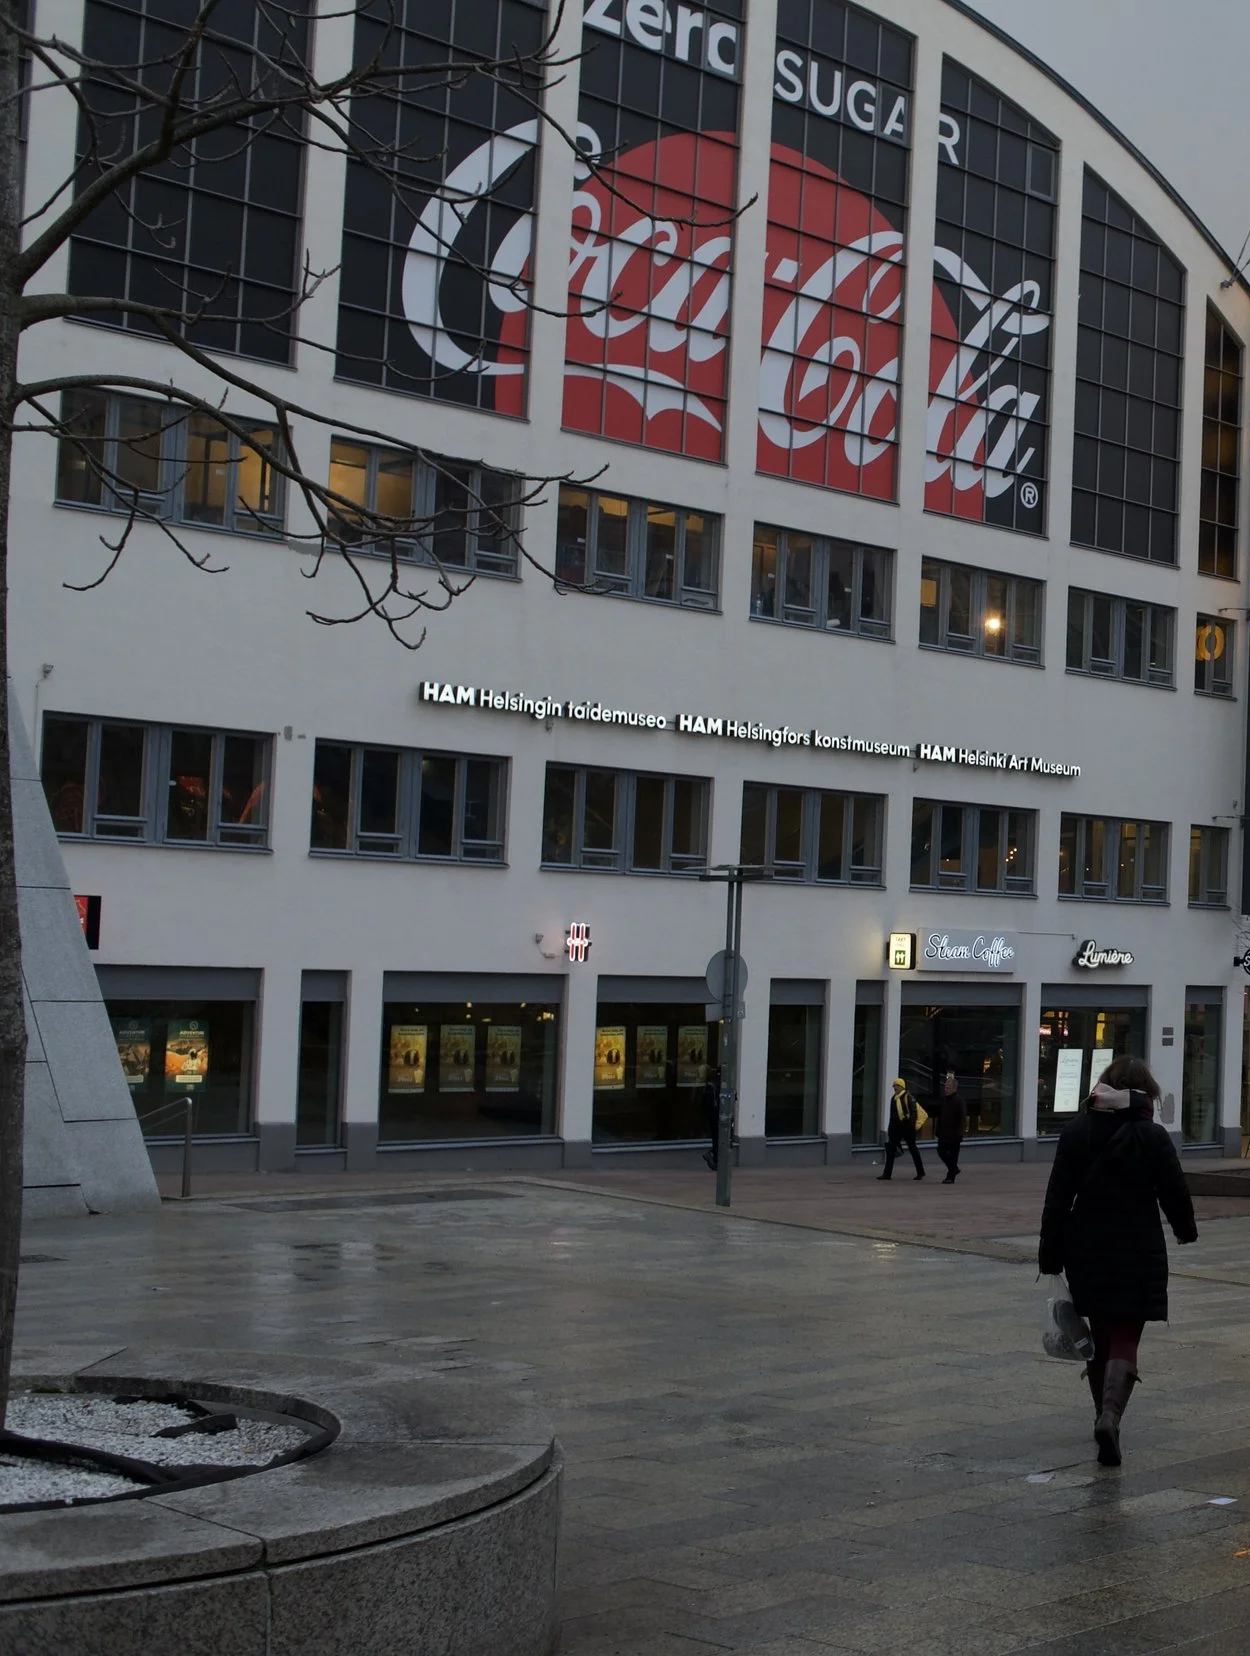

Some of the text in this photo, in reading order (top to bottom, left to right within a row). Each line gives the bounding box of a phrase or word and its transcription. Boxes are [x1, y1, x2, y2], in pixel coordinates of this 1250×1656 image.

[774, 50, 961, 164] SUGAR
[402, 118, 1050, 500] Coca-Cola
[423, 681, 1082, 778] HAM Helsingin taidemuseo HAM Helsingfors konstmuseum HAM Helsinki Art Museum
[925, 933, 1015, 967] Steam Coffee
